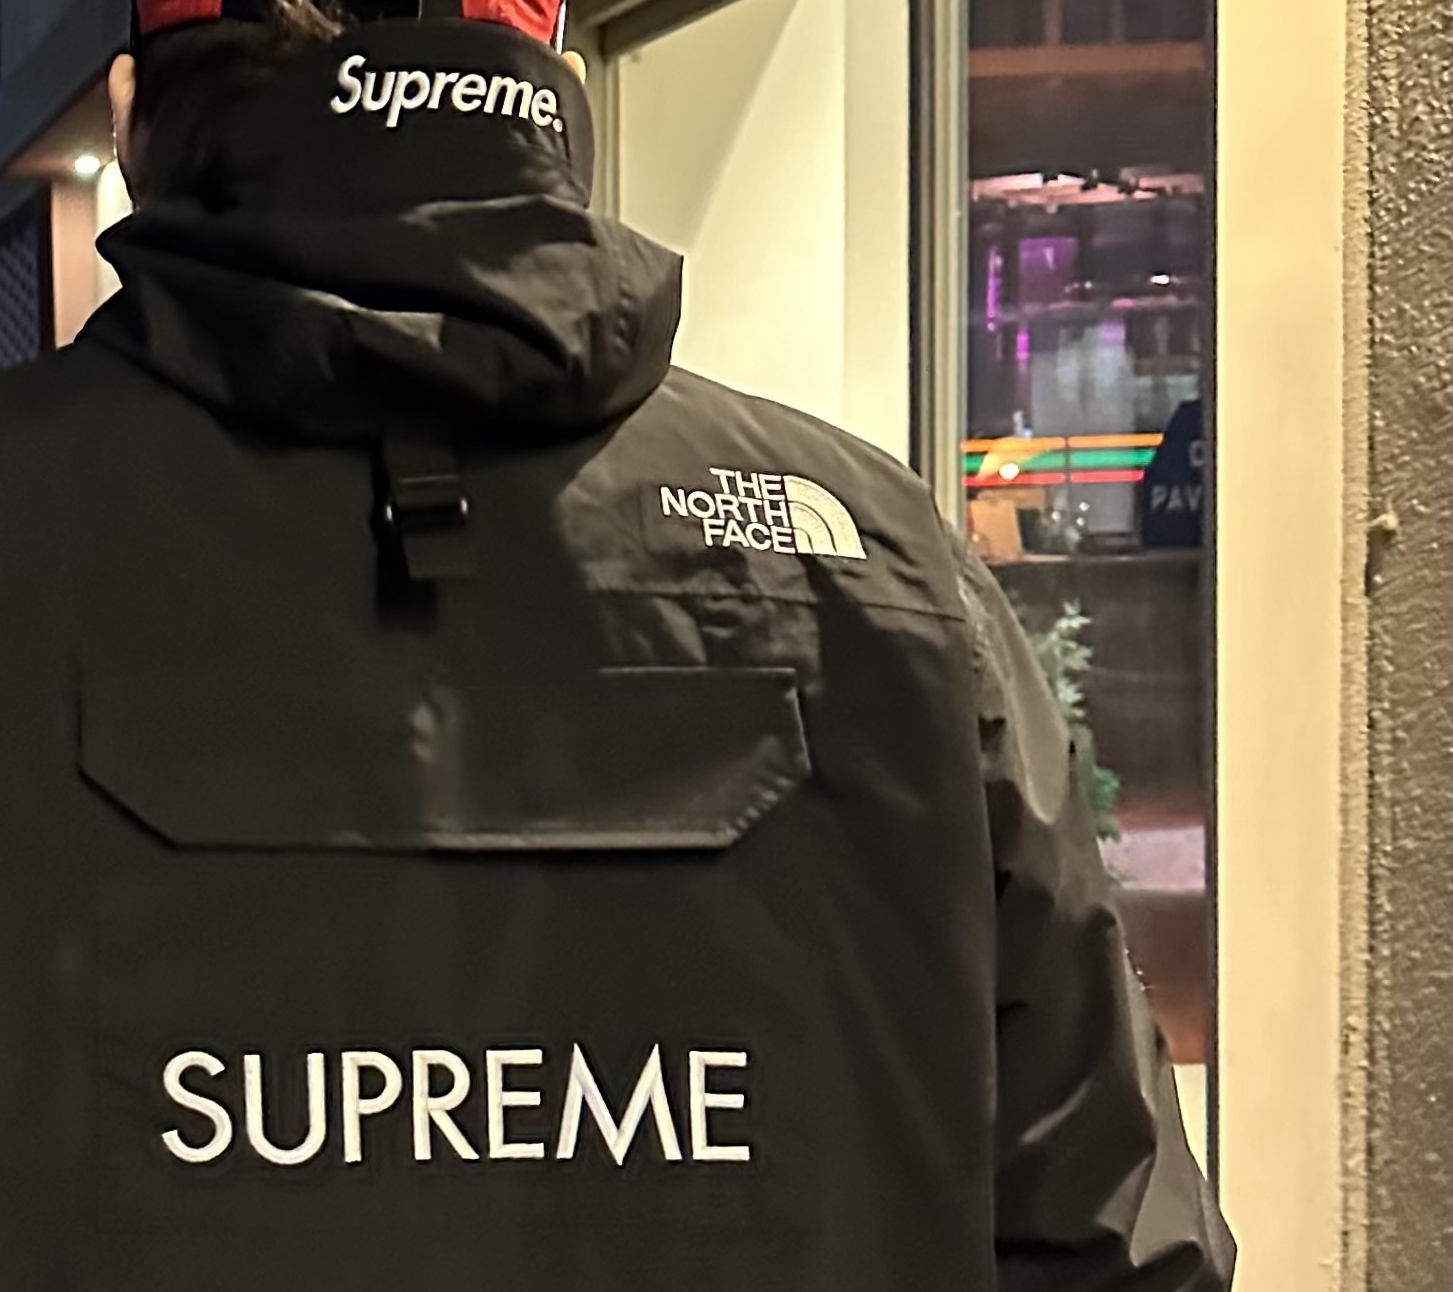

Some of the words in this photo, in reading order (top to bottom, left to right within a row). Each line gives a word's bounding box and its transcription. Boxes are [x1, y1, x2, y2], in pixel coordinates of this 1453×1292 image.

[709, 467, 785, 501] THE
[660, 486, 790, 527] NORTH
[702, 518, 796, 554] FACE
[161, 1042, 751, 1166] SUPREME
